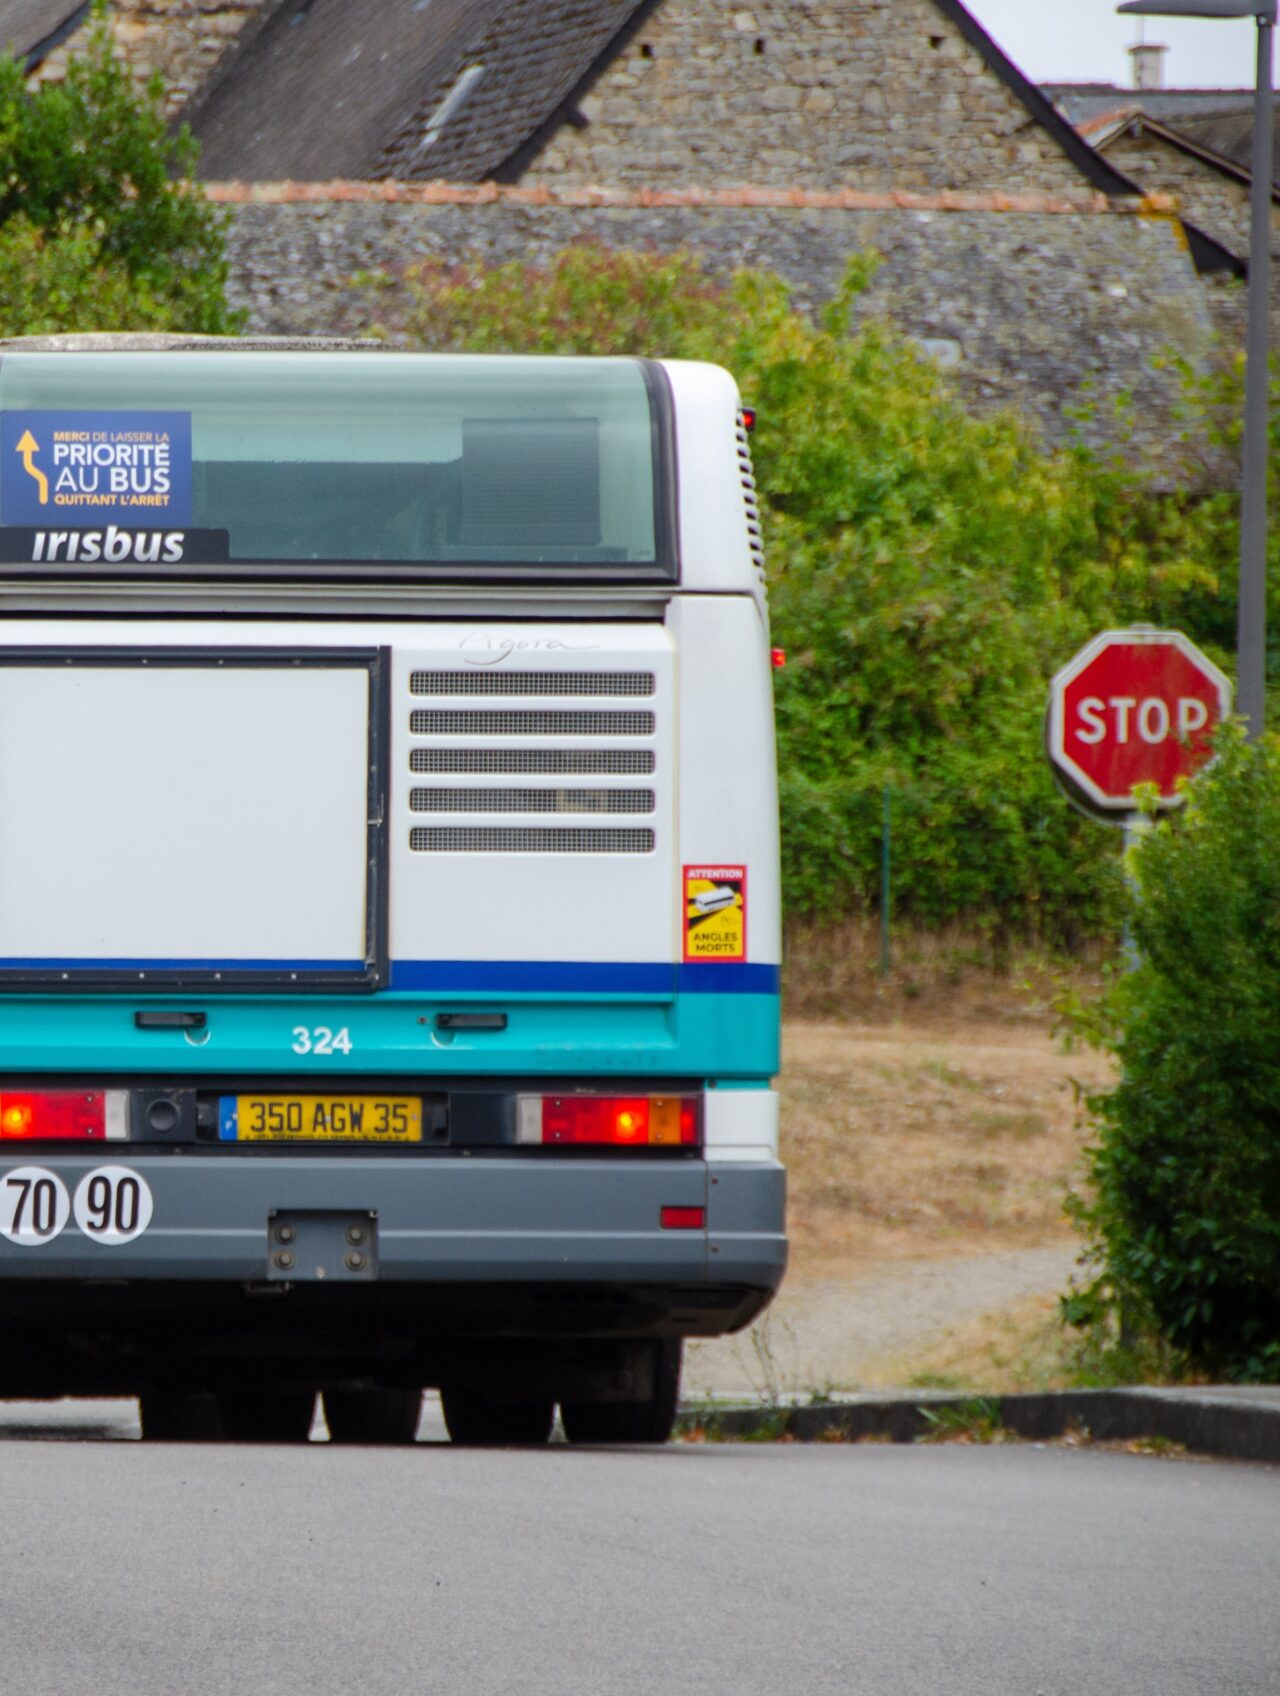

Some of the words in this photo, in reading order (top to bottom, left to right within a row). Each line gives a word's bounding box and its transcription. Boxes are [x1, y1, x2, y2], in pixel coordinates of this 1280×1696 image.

[53, 432, 90, 443] MERCI
[92, 432, 108, 442] DE
[110, 432, 152, 443] LAISSER
[155, 432, 169, 443] LA
[53, 442, 170, 466] PRIORITÉ
[55, 467, 98, 492] AU
[110, 467, 170, 493] BUS
[54, 494, 118, 505] QUITTANT
[120, 494, 169, 506] L'ARRÊT
[31, 525, 185, 562] irisbus
[1075, 697, 1208, 744] STOP
[688, 869, 742, 879] ATTENTION
[694, 932, 738, 942] ANGLES
[696, 943, 736, 953] MORTS
[291, 1026, 353, 1055] 324
[250, 1102, 303, 1132] 350
[312, 1102, 364, 1133] AGW
[374, 1103, 408, 1133] 35
[6, 1178, 57, 1236] 70
[87, 1175, 140, 1235] 90
